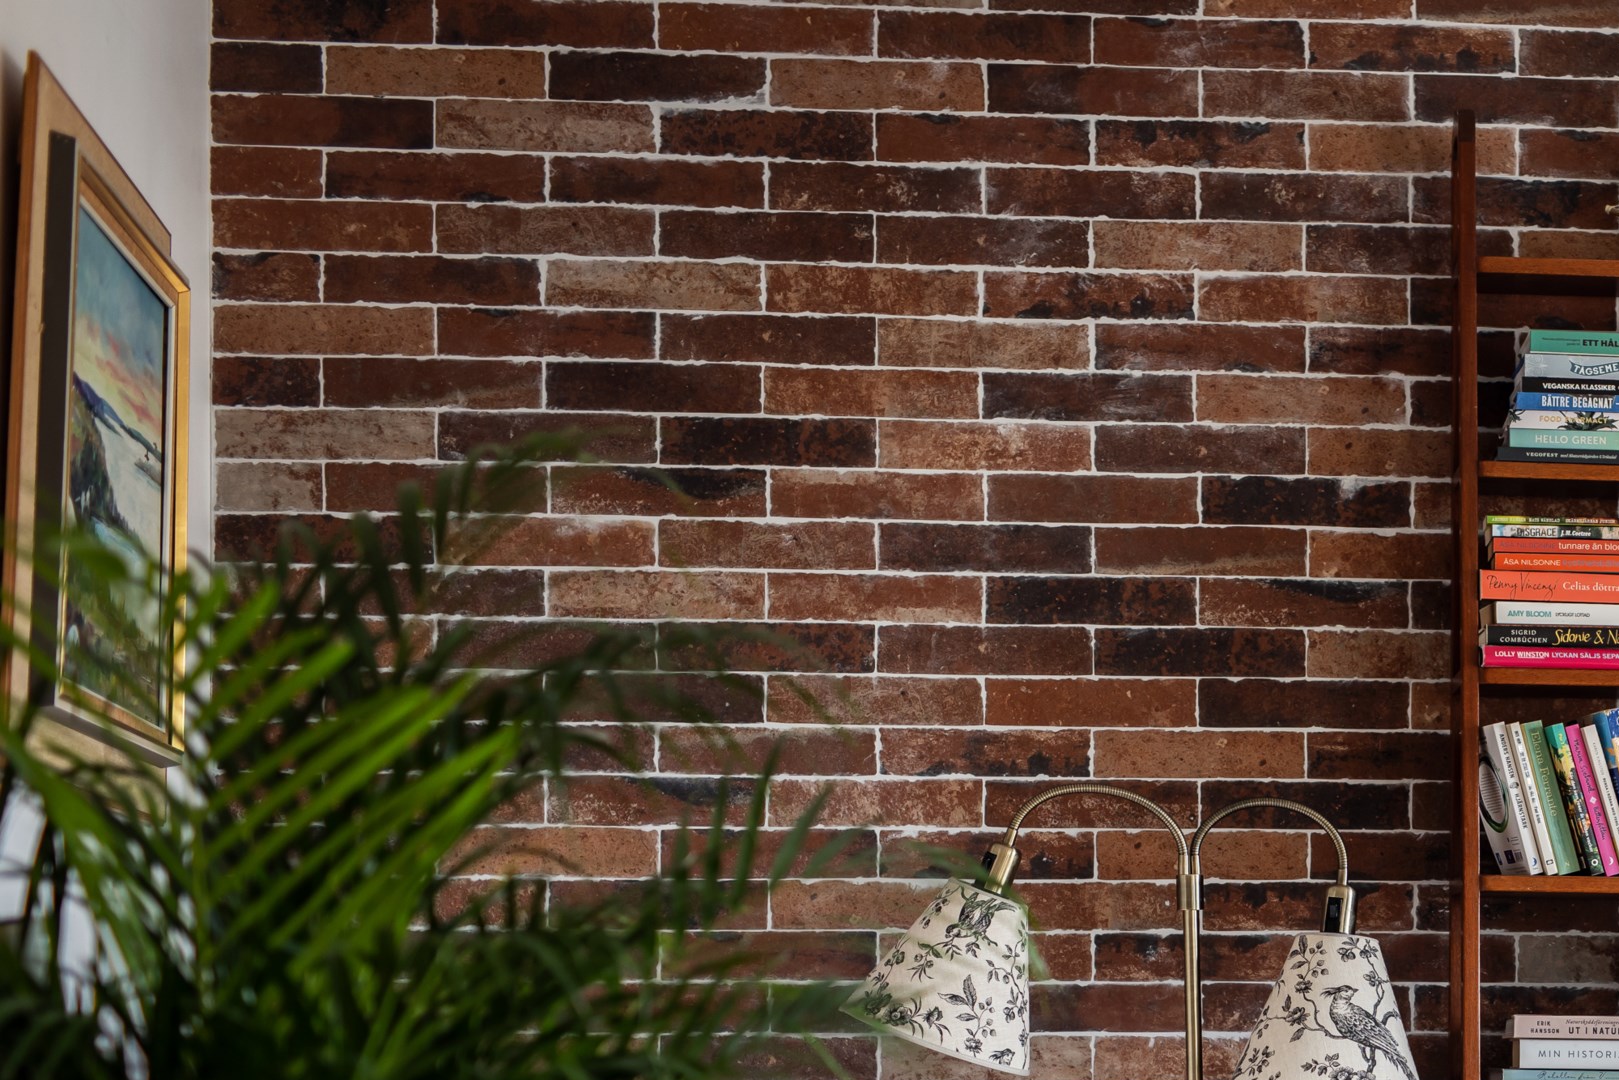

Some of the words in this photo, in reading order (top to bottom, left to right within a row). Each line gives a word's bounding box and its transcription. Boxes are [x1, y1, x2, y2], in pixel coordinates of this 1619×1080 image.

[1582, 339, 1599, 348] ETT
[1542, 382, 1580, 391] VEGANSKA
[1580, 383, 1616, 392] KLASSIKER
[1542, 395, 1571, 408] BÄTTRE
[1535, 434, 1568, 444] HELLO
[1572, 436, 1607, 445] GREEN
[1558, 543, 1591, 551] tunnare
[1592, 542, 1602, 550] än
[1504, 558, 1519, 566] ÅSA
[1562, 582, 1591, 592] Celias
[1526, 610, 1552, 618] BLOOM
[1500, 635, 1548, 644] COMBÜCHEN
[1552, 628, 1591, 646] Sidonie
[1494, 650, 1515, 658] LOLLY
[1517, 650, 1550, 659] WINSTON
[1580, 650, 1601, 660] SÄLJS
[1499, 733, 1510, 755] ANDERS
[1504, 756, 1515, 779] HANSEN
[1514, 793, 1529, 829] HJÄRNSTARK
[1568, 1026, 1584, 1035] UT
[1538, 1050, 1561, 1058] MIN
